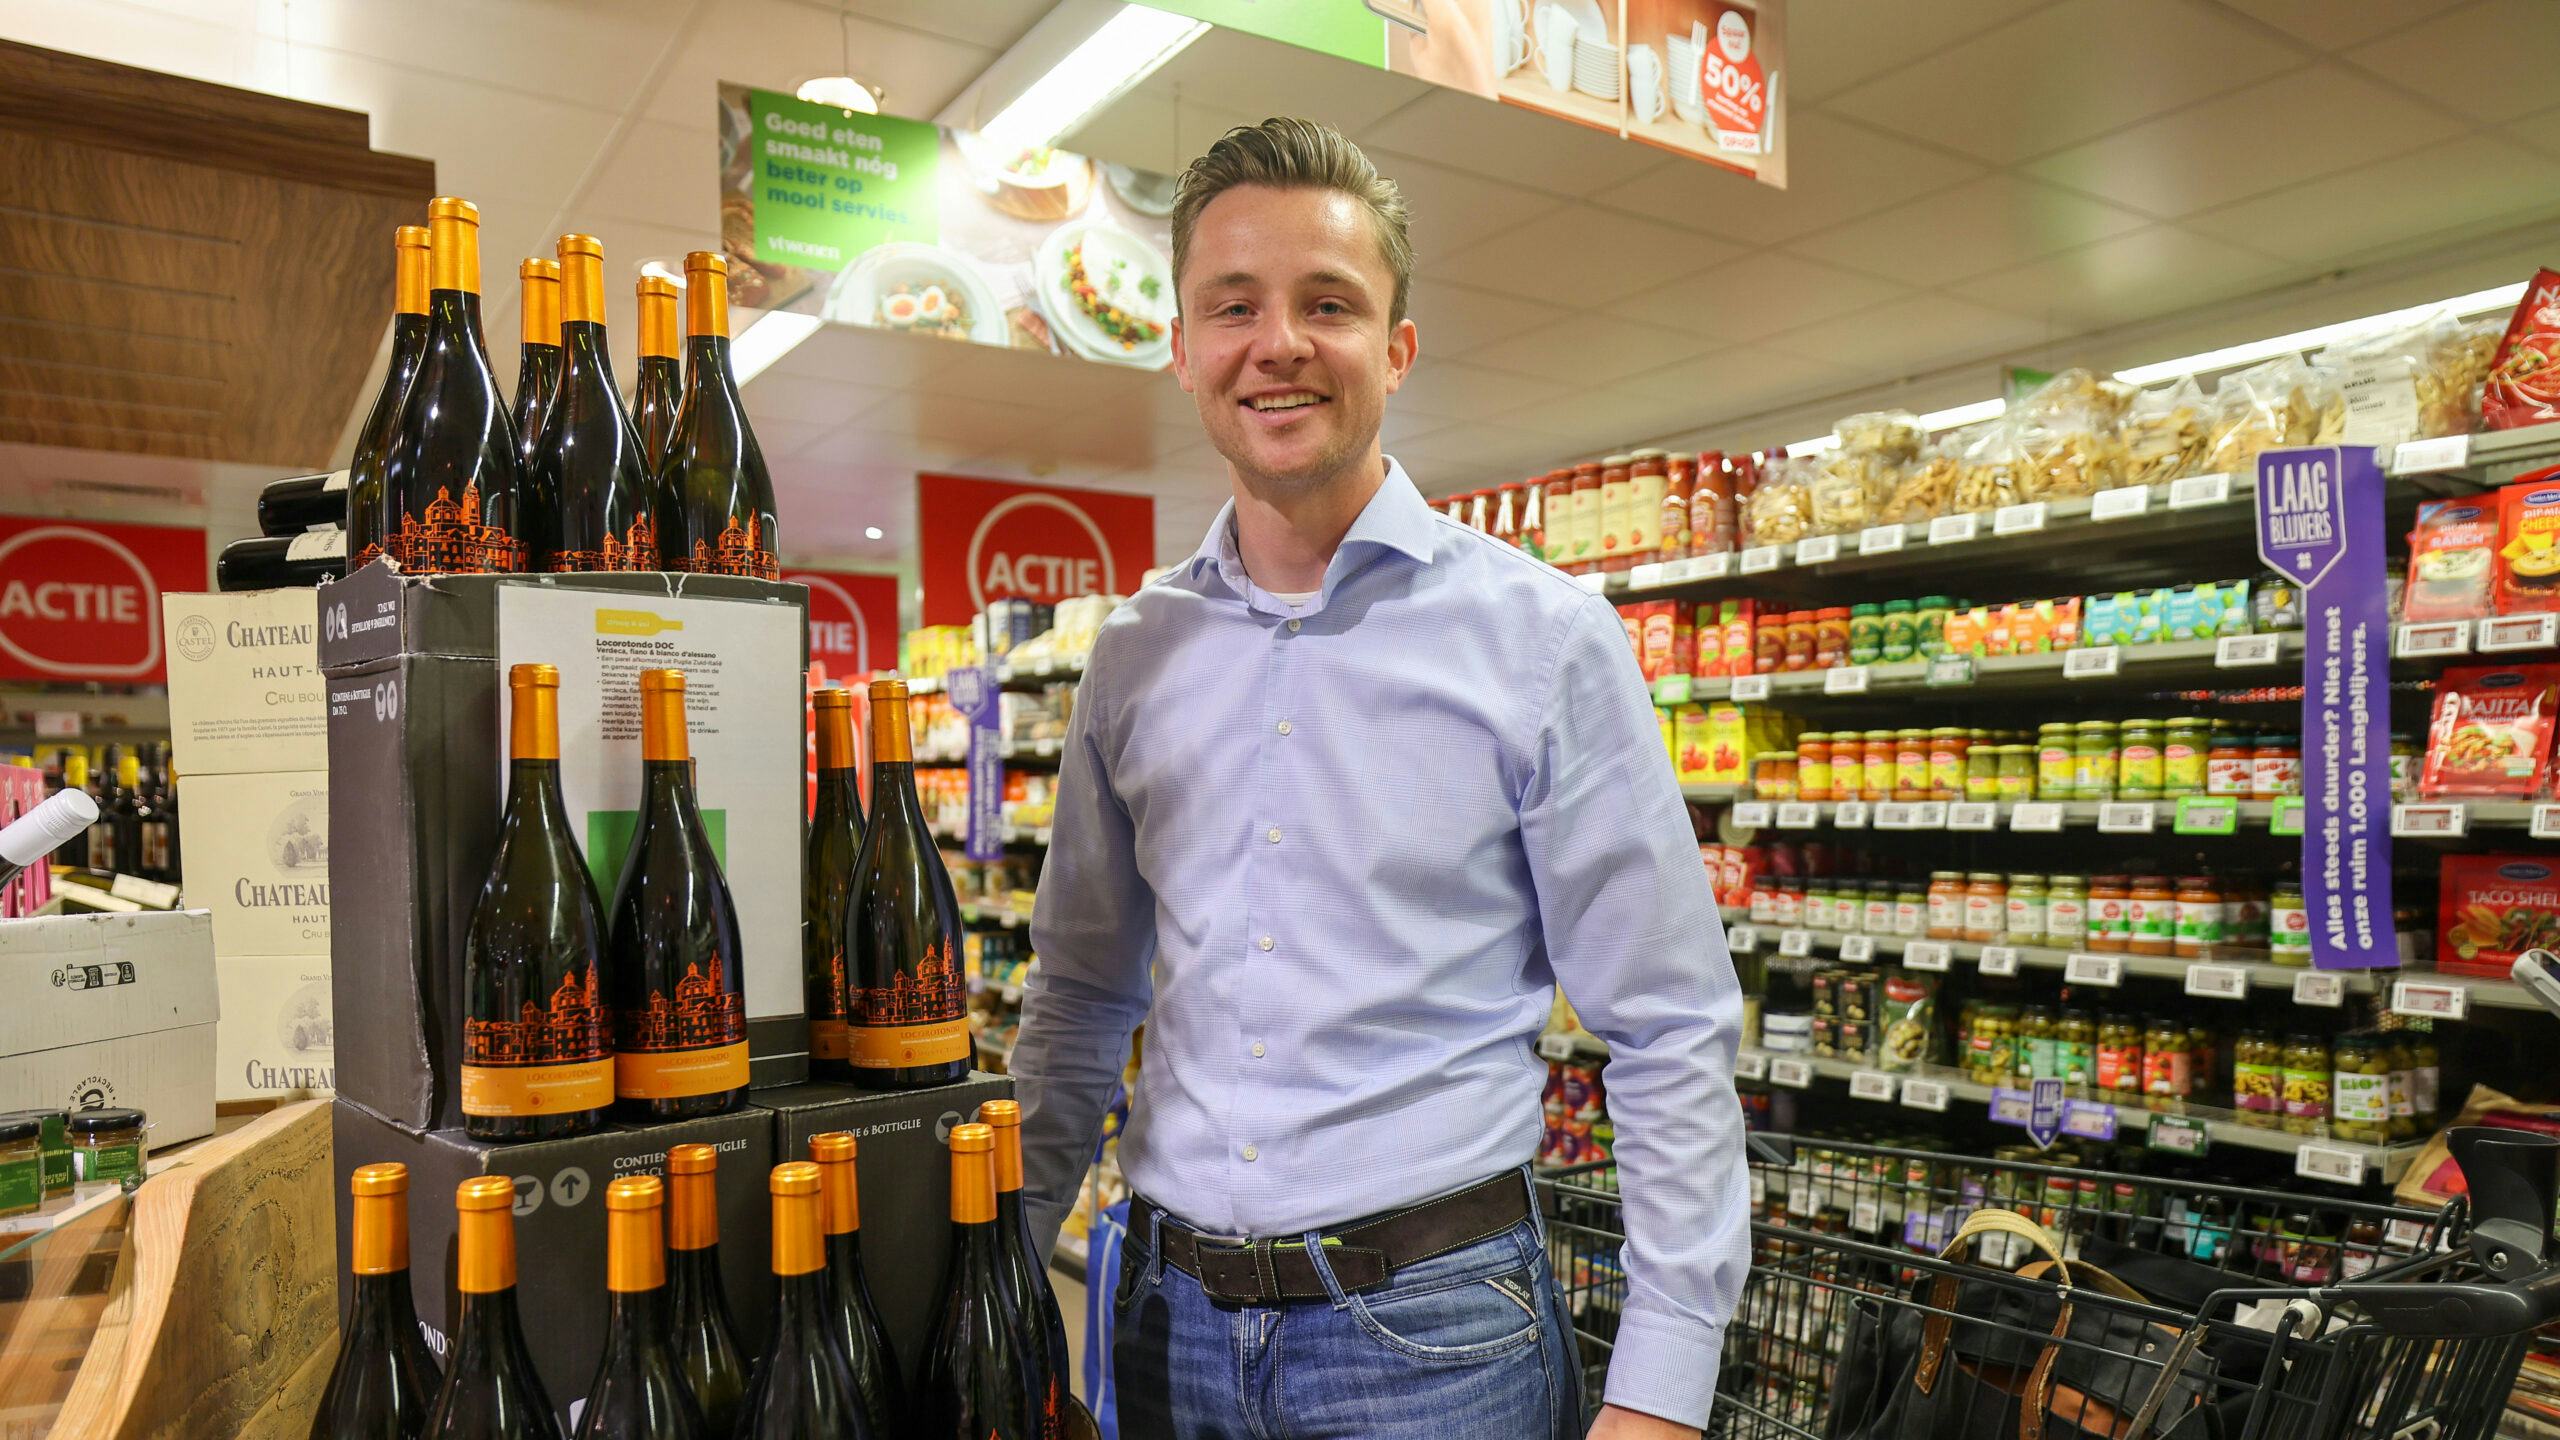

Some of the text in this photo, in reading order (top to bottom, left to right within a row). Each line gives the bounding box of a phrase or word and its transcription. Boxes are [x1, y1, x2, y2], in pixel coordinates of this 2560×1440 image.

[1704, 53, 1762, 112] 50%
[765, 112, 882, 150] Goed eten
[766, 138, 848, 168] smaakt
[766, 160, 863, 194] beter op
[767, 186, 824, 208] mooi
[2267, 460, 2328, 514] LAAG
[985, 552, 1099, 596] ACTIE
[0, 579, 139, 624] ACTIE
[178, 636, 214, 648] CASTEL
[226, 620, 312, 648] CHATEAU
[596, 638, 674, 650] Locorotondo DOC
[808, 620, 854, 654] TIE
[596, 647, 628, 655] Verdeca,
[630, 648, 648, 656] fiano
[650, 648, 654, 656] &
[656, 649, 679, 657] bianco
[265, 691, 295, 706] CRU
[2323, 606, 2347, 950] Alles steeds duurder? Niet met
[2348, 621, 2373, 950] onze ruim 1.000 Laagblijvers.
[235, 878, 330, 908] CHATEAU
[2467, 890, 2514, 904] TACO
[293, 914, 328, 924] HAUT
[302, 929, 323, 940] CRU
[70, 1076, 114, 1102] RECYCLABLE
[862, 1127, 869, 1136] 6
[872, 1118, 922, 1135] BOTTIGLIE
[710, 1138, 748, 1153] TIGLIE
[1504, 1278, 1530, 1300] REPLAY
